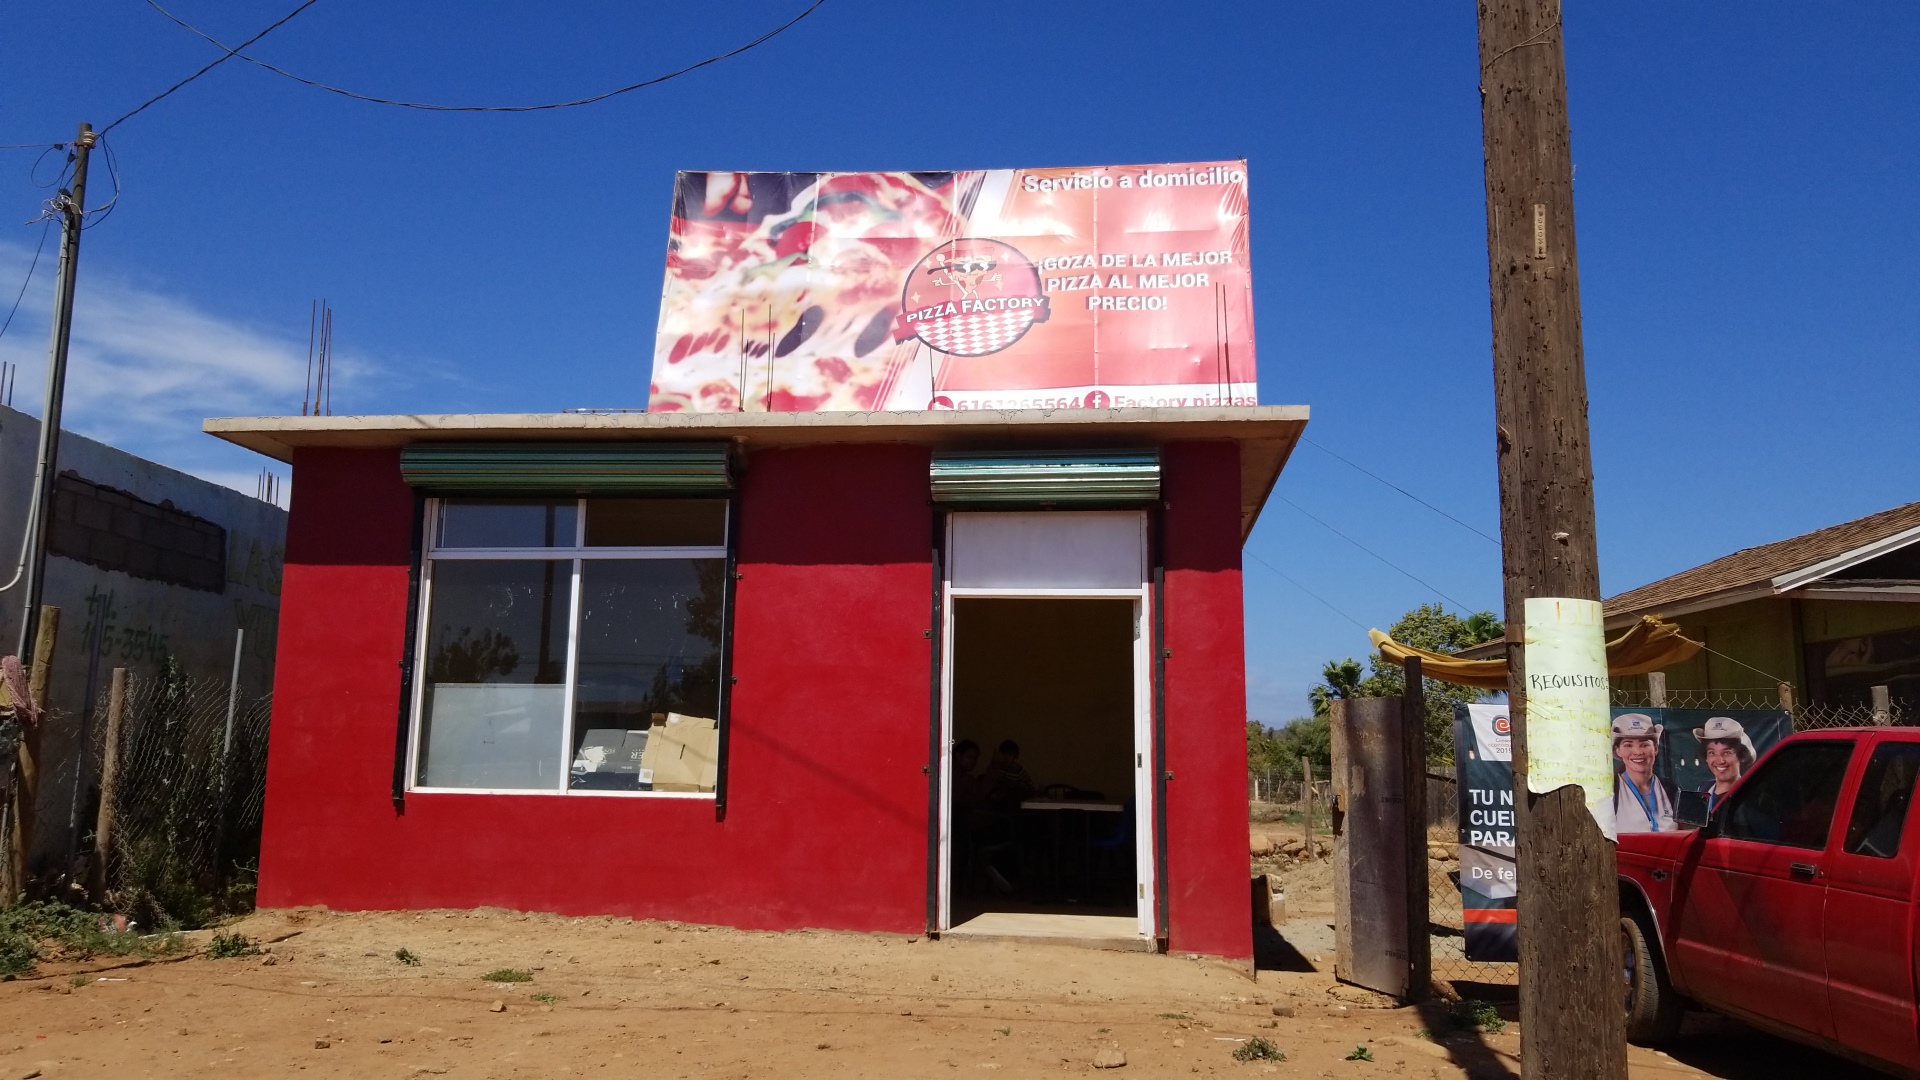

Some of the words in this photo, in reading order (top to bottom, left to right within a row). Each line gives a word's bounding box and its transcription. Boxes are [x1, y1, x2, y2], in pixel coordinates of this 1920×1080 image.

[1023, 172, 1114, 192] Servicio
[1119, 176, 1132, 189] a
[1138, 167, 1244, 188] domicilio
[1101, 254, 1127, 268] DE
[1132, 253, 1157, 268] LA
[1162, 251, 1232, 267] MEJOR
[1047, 274, 1103, 292] PIZZA
[1108, 274, 1133, 289] AL
[1139, 273, 1209, 289] MEJOR
[906, 303, 958, 323] PIZZA
[962, 298, 1045, 314] FACTORY
[1088, 295, 1167, 311] PRECIO!
[1529, 674, 1609, 691] REQUISITOS:
[1469, 789, 1494, 805] TU
[1500, 790, 1513, 806] N
[1472, 866, 1493, 879] De
[1498, 866, 1516, 880] fe
